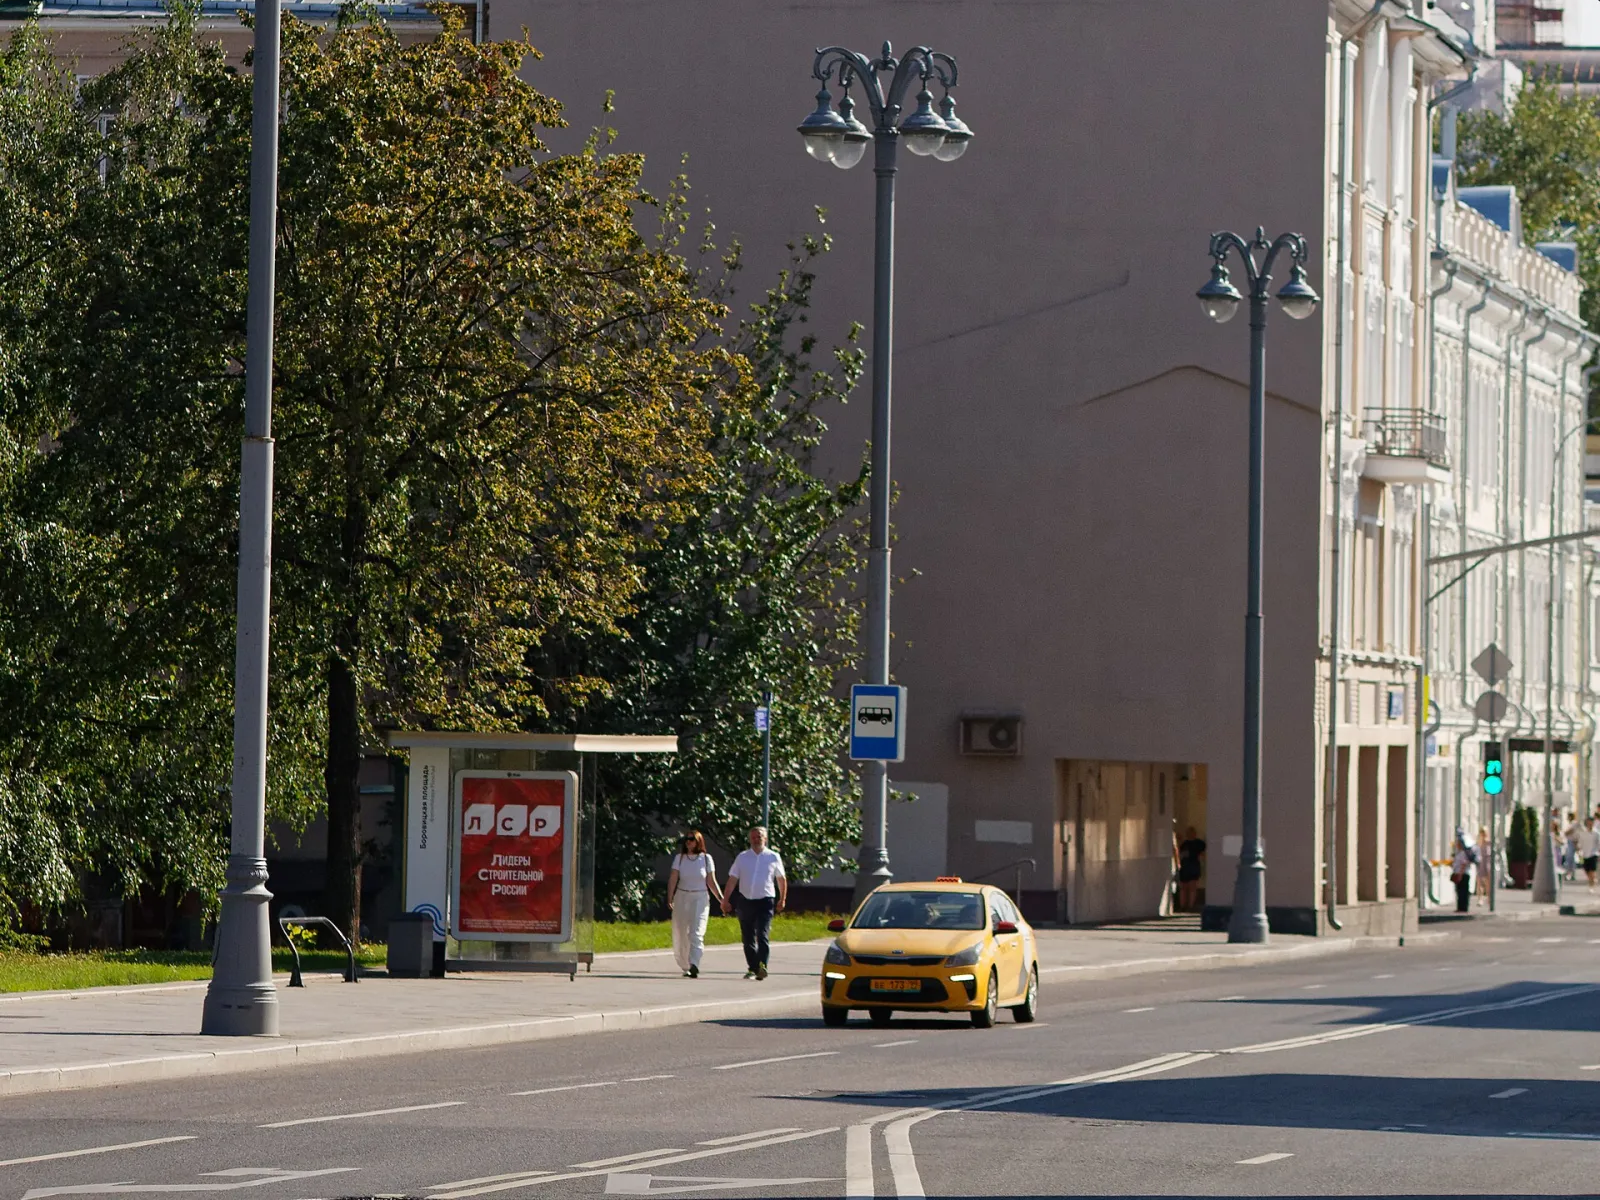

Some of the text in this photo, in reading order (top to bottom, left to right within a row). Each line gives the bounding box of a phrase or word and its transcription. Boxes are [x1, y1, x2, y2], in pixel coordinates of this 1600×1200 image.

[420, 801, 428, 850] Боровицкая
[468, 816, 547, 832] ЛСР
[491, 854, 531, 867] ЛИДЕРЫ
[478, 868, 544, 882] СТРОИТЕЛЬНОЙ
